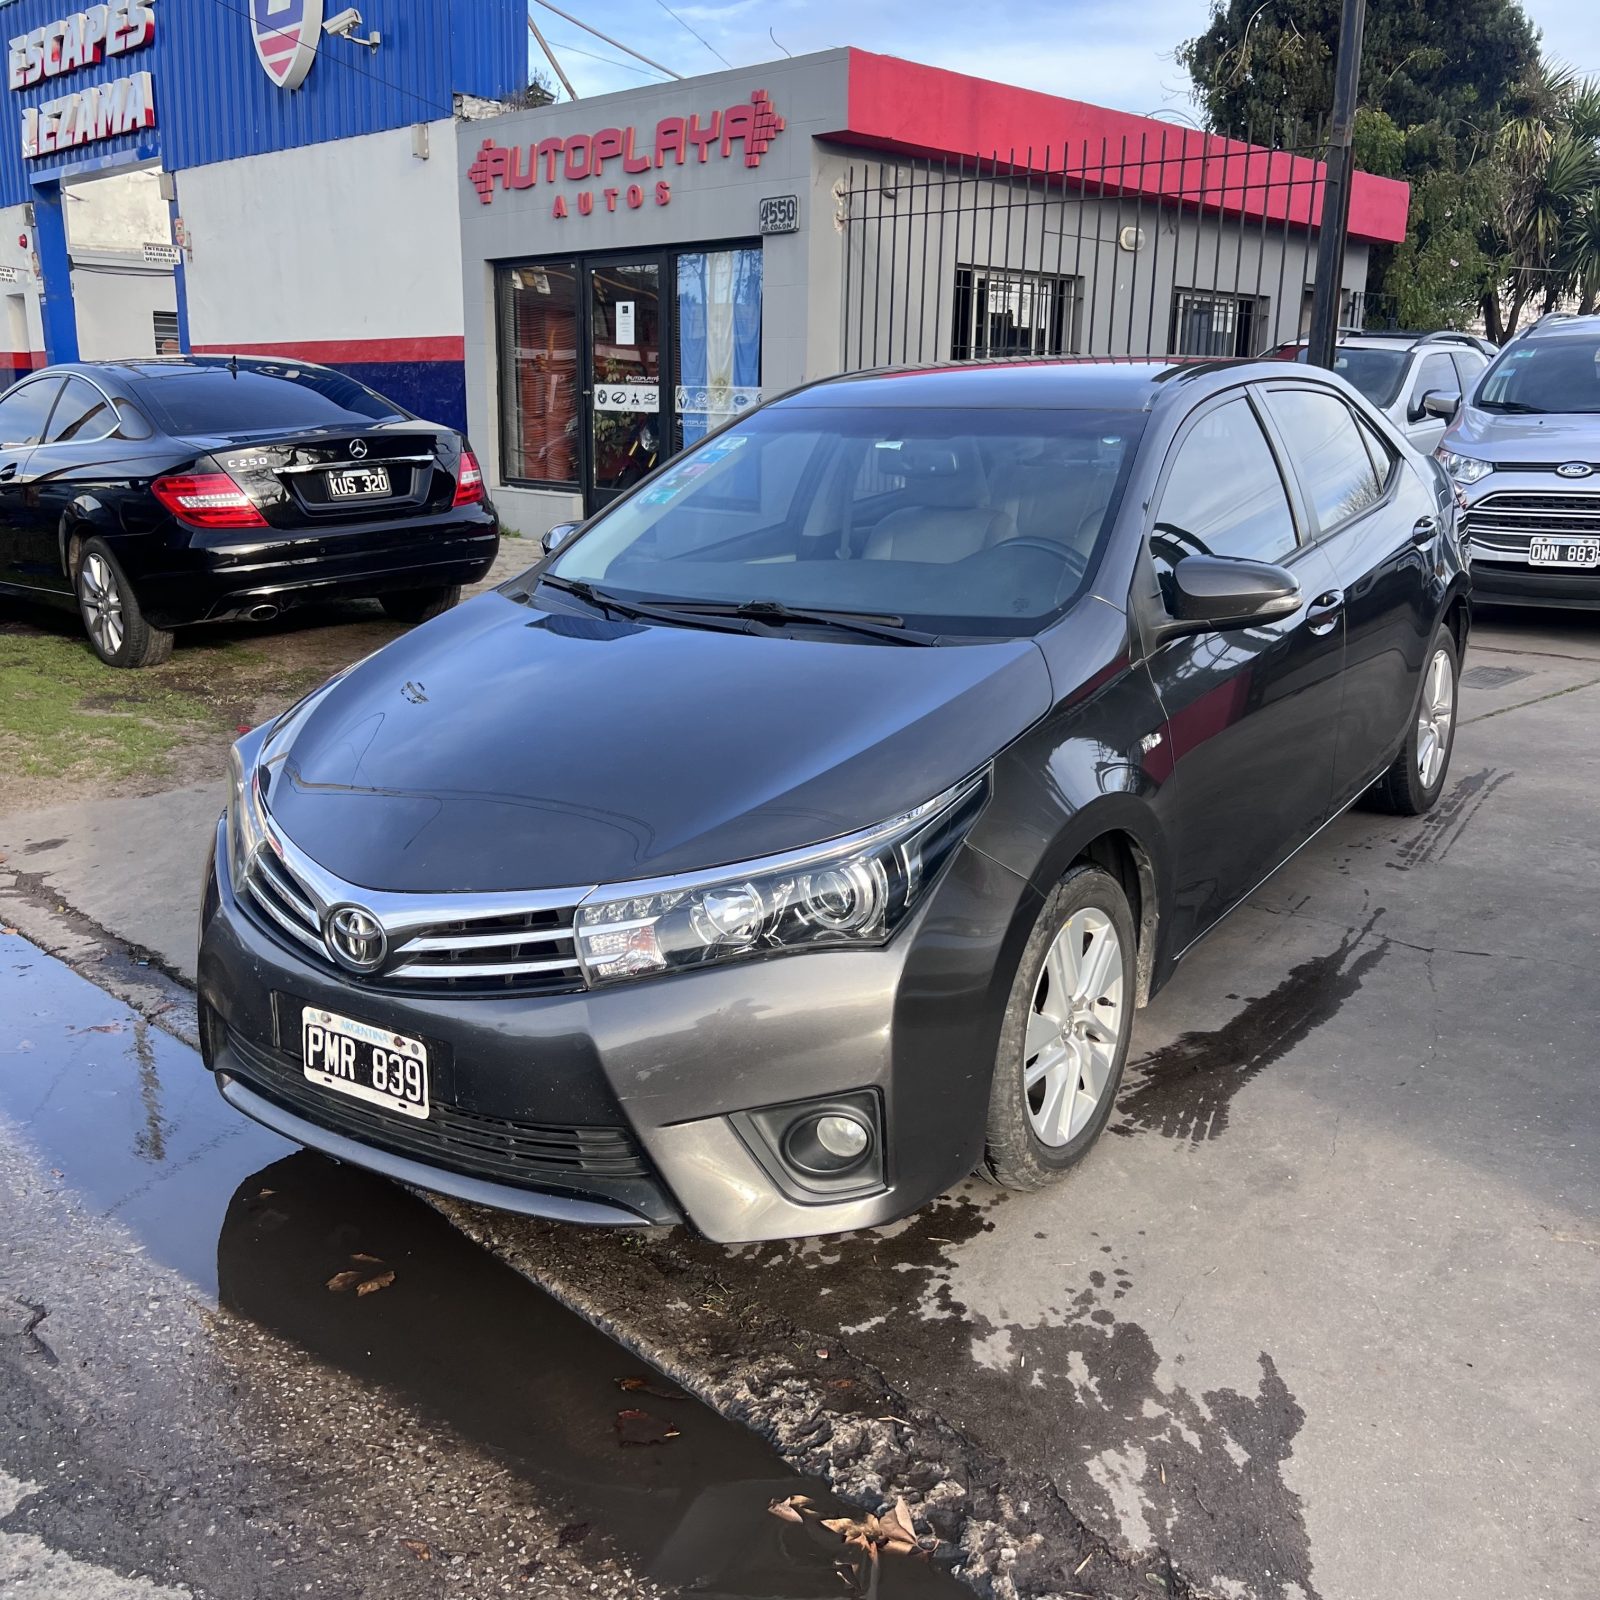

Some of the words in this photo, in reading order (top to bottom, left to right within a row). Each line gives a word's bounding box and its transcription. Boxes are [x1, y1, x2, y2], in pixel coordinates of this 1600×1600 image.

[9, 0, 155, 90] ESCAPES
[22, 71, 155, 158] LEZAMA
[486, 104, 758, 189] AUTOPLAYA
[552, 180, 672, 218] AUTOS
[761, 199, 795, 225] 4550
[227, 460, 236, 468] C
[239, 457, 268, 467] 250
[330, 477, 357, 495] KUS
[361, 474, 388, 491] 320
[1567, 546, 1597, 562] 883
[308, 1026, 356, 1081] PMR
[373, 1047, 421, 1102] 839
